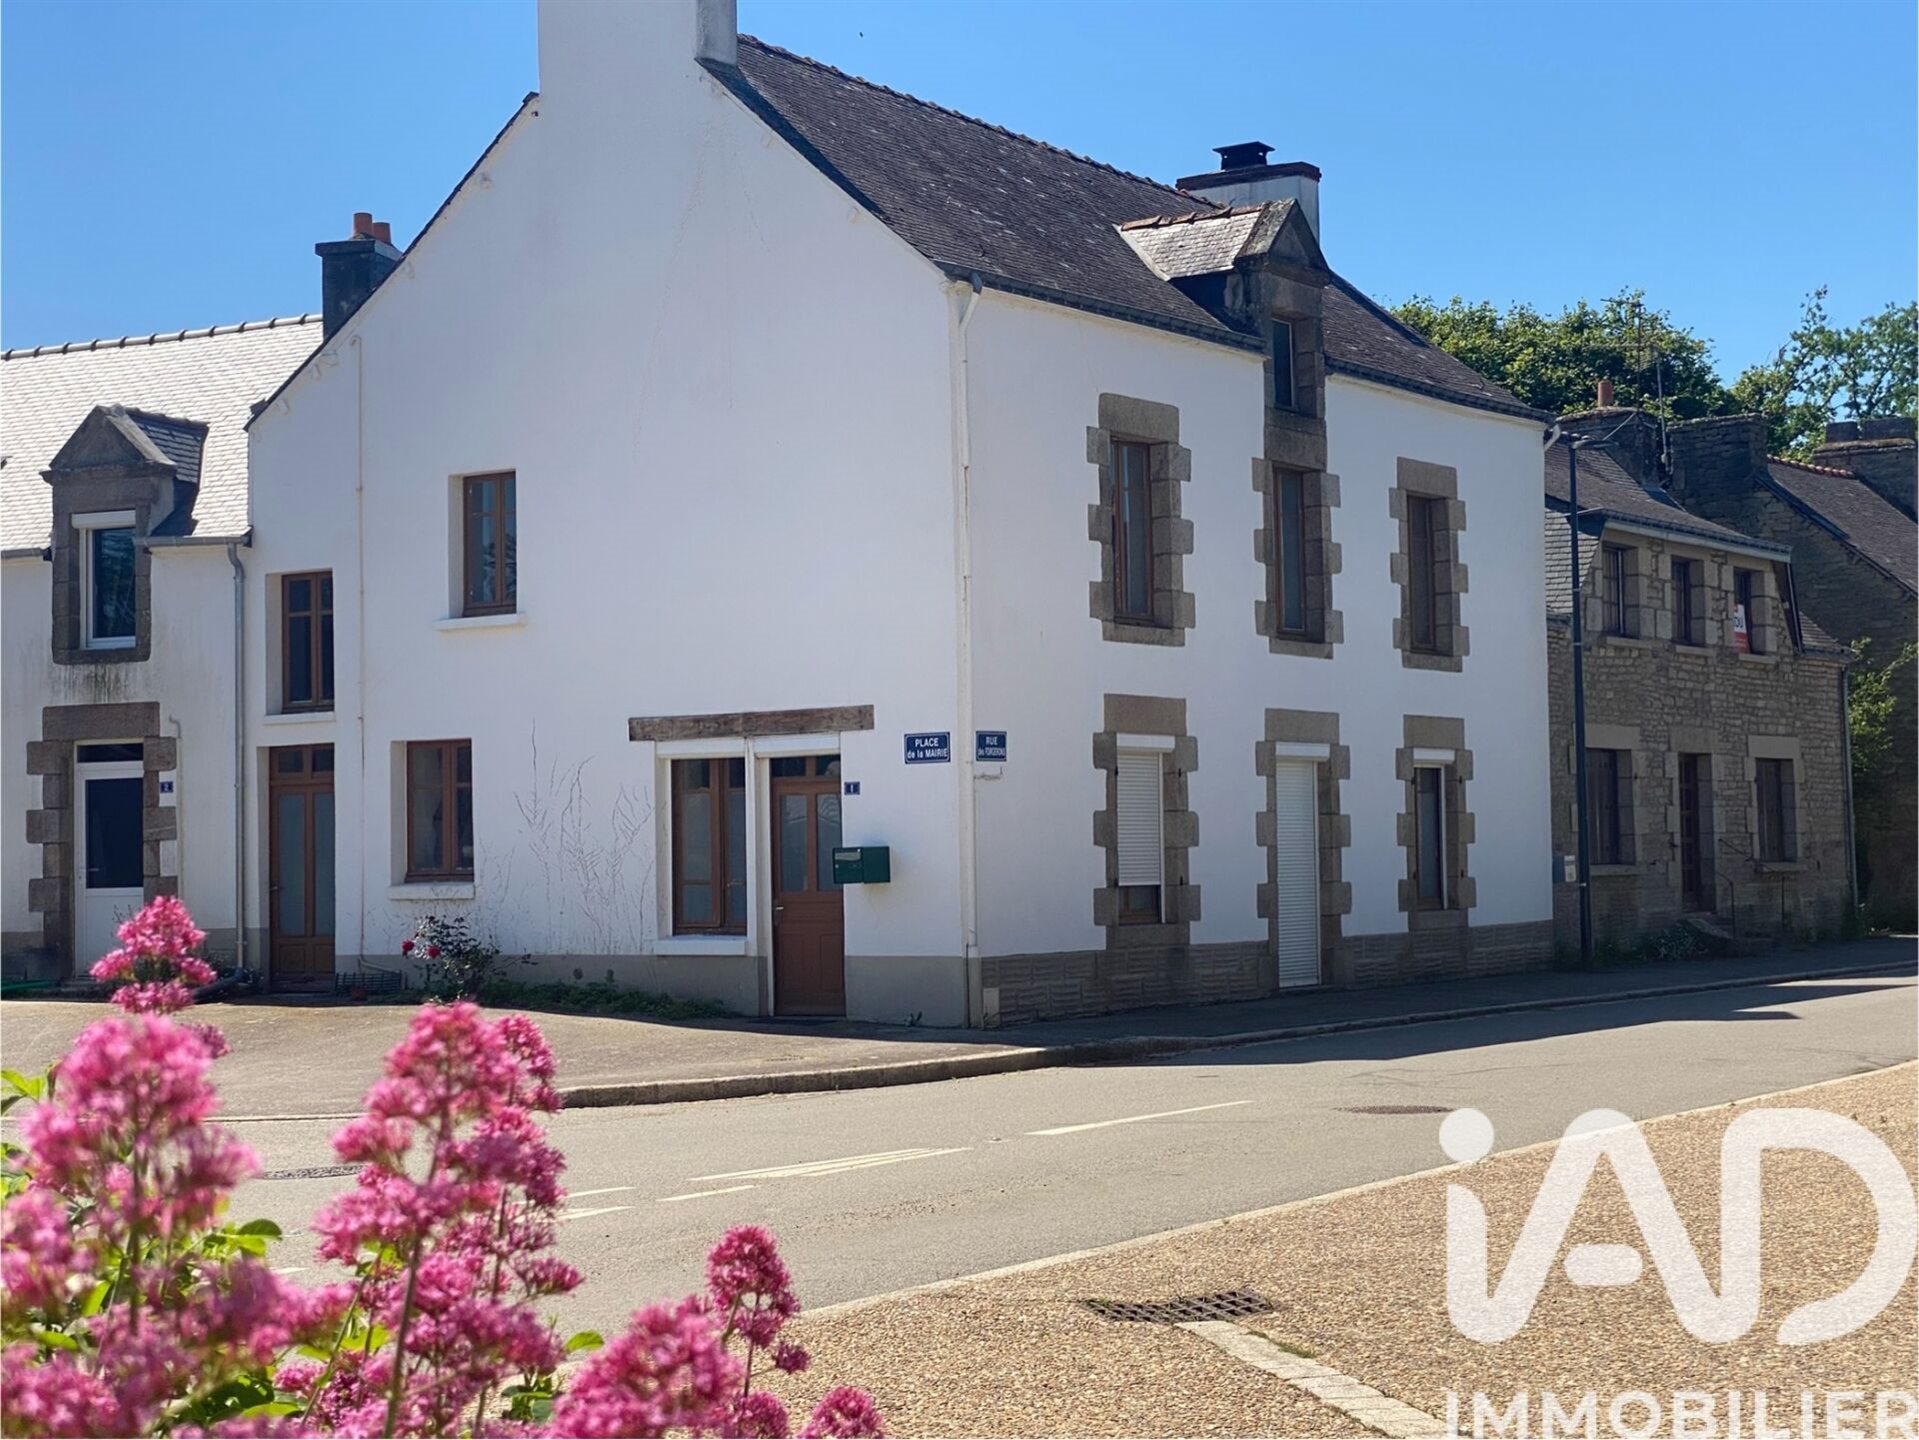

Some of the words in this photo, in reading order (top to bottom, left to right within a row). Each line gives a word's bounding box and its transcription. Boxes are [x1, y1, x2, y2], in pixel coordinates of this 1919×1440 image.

[915, 738, 939, 747] PLACE
[985, 736, 998, 745] RUE
[907, 750, 916, 759] de
[917, 750, 924, 758] la
[925, 748, 948, 758] MAIRIE
